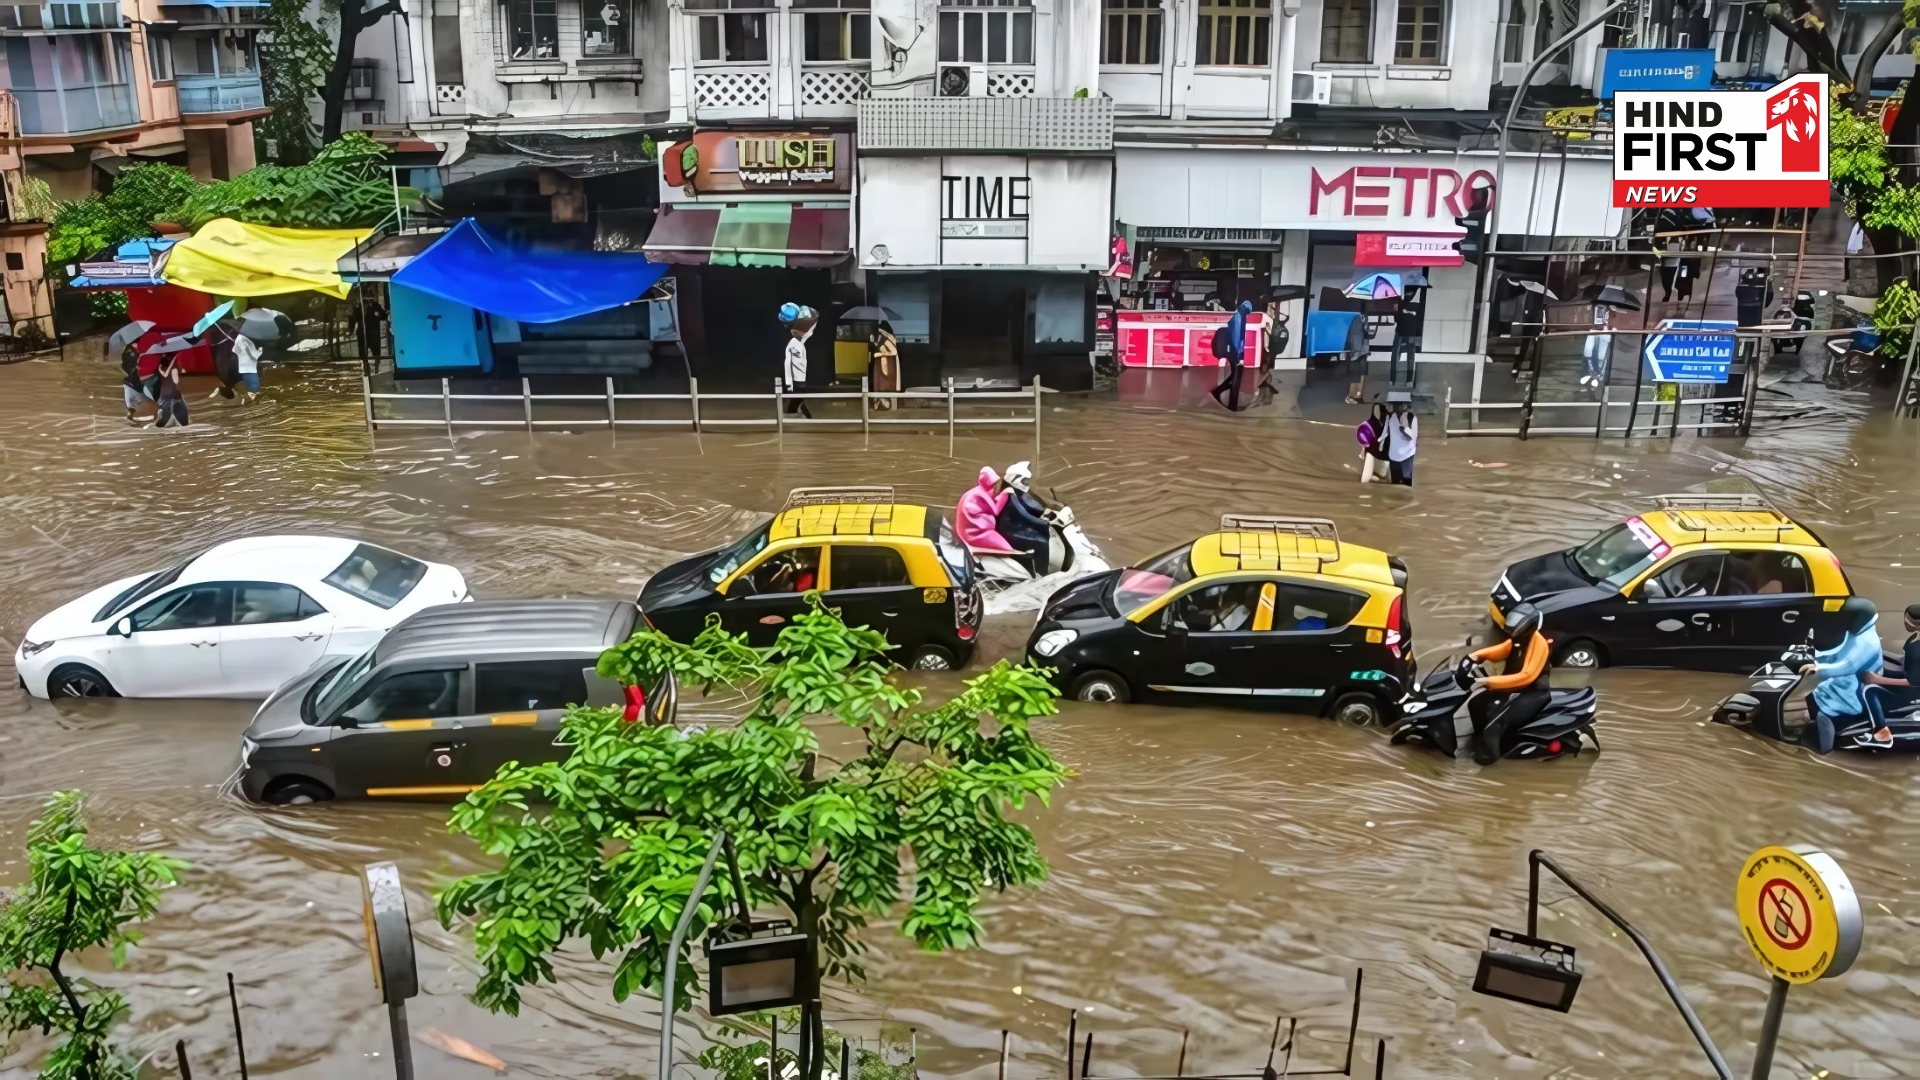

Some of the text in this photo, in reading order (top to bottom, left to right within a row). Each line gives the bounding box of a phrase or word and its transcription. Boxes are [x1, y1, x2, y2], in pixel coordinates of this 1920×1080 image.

[738, 139, 835, 168] LUSH
[941, 175, 1031, 218] TIME
[1309, 166, 1497, 218] METRO
